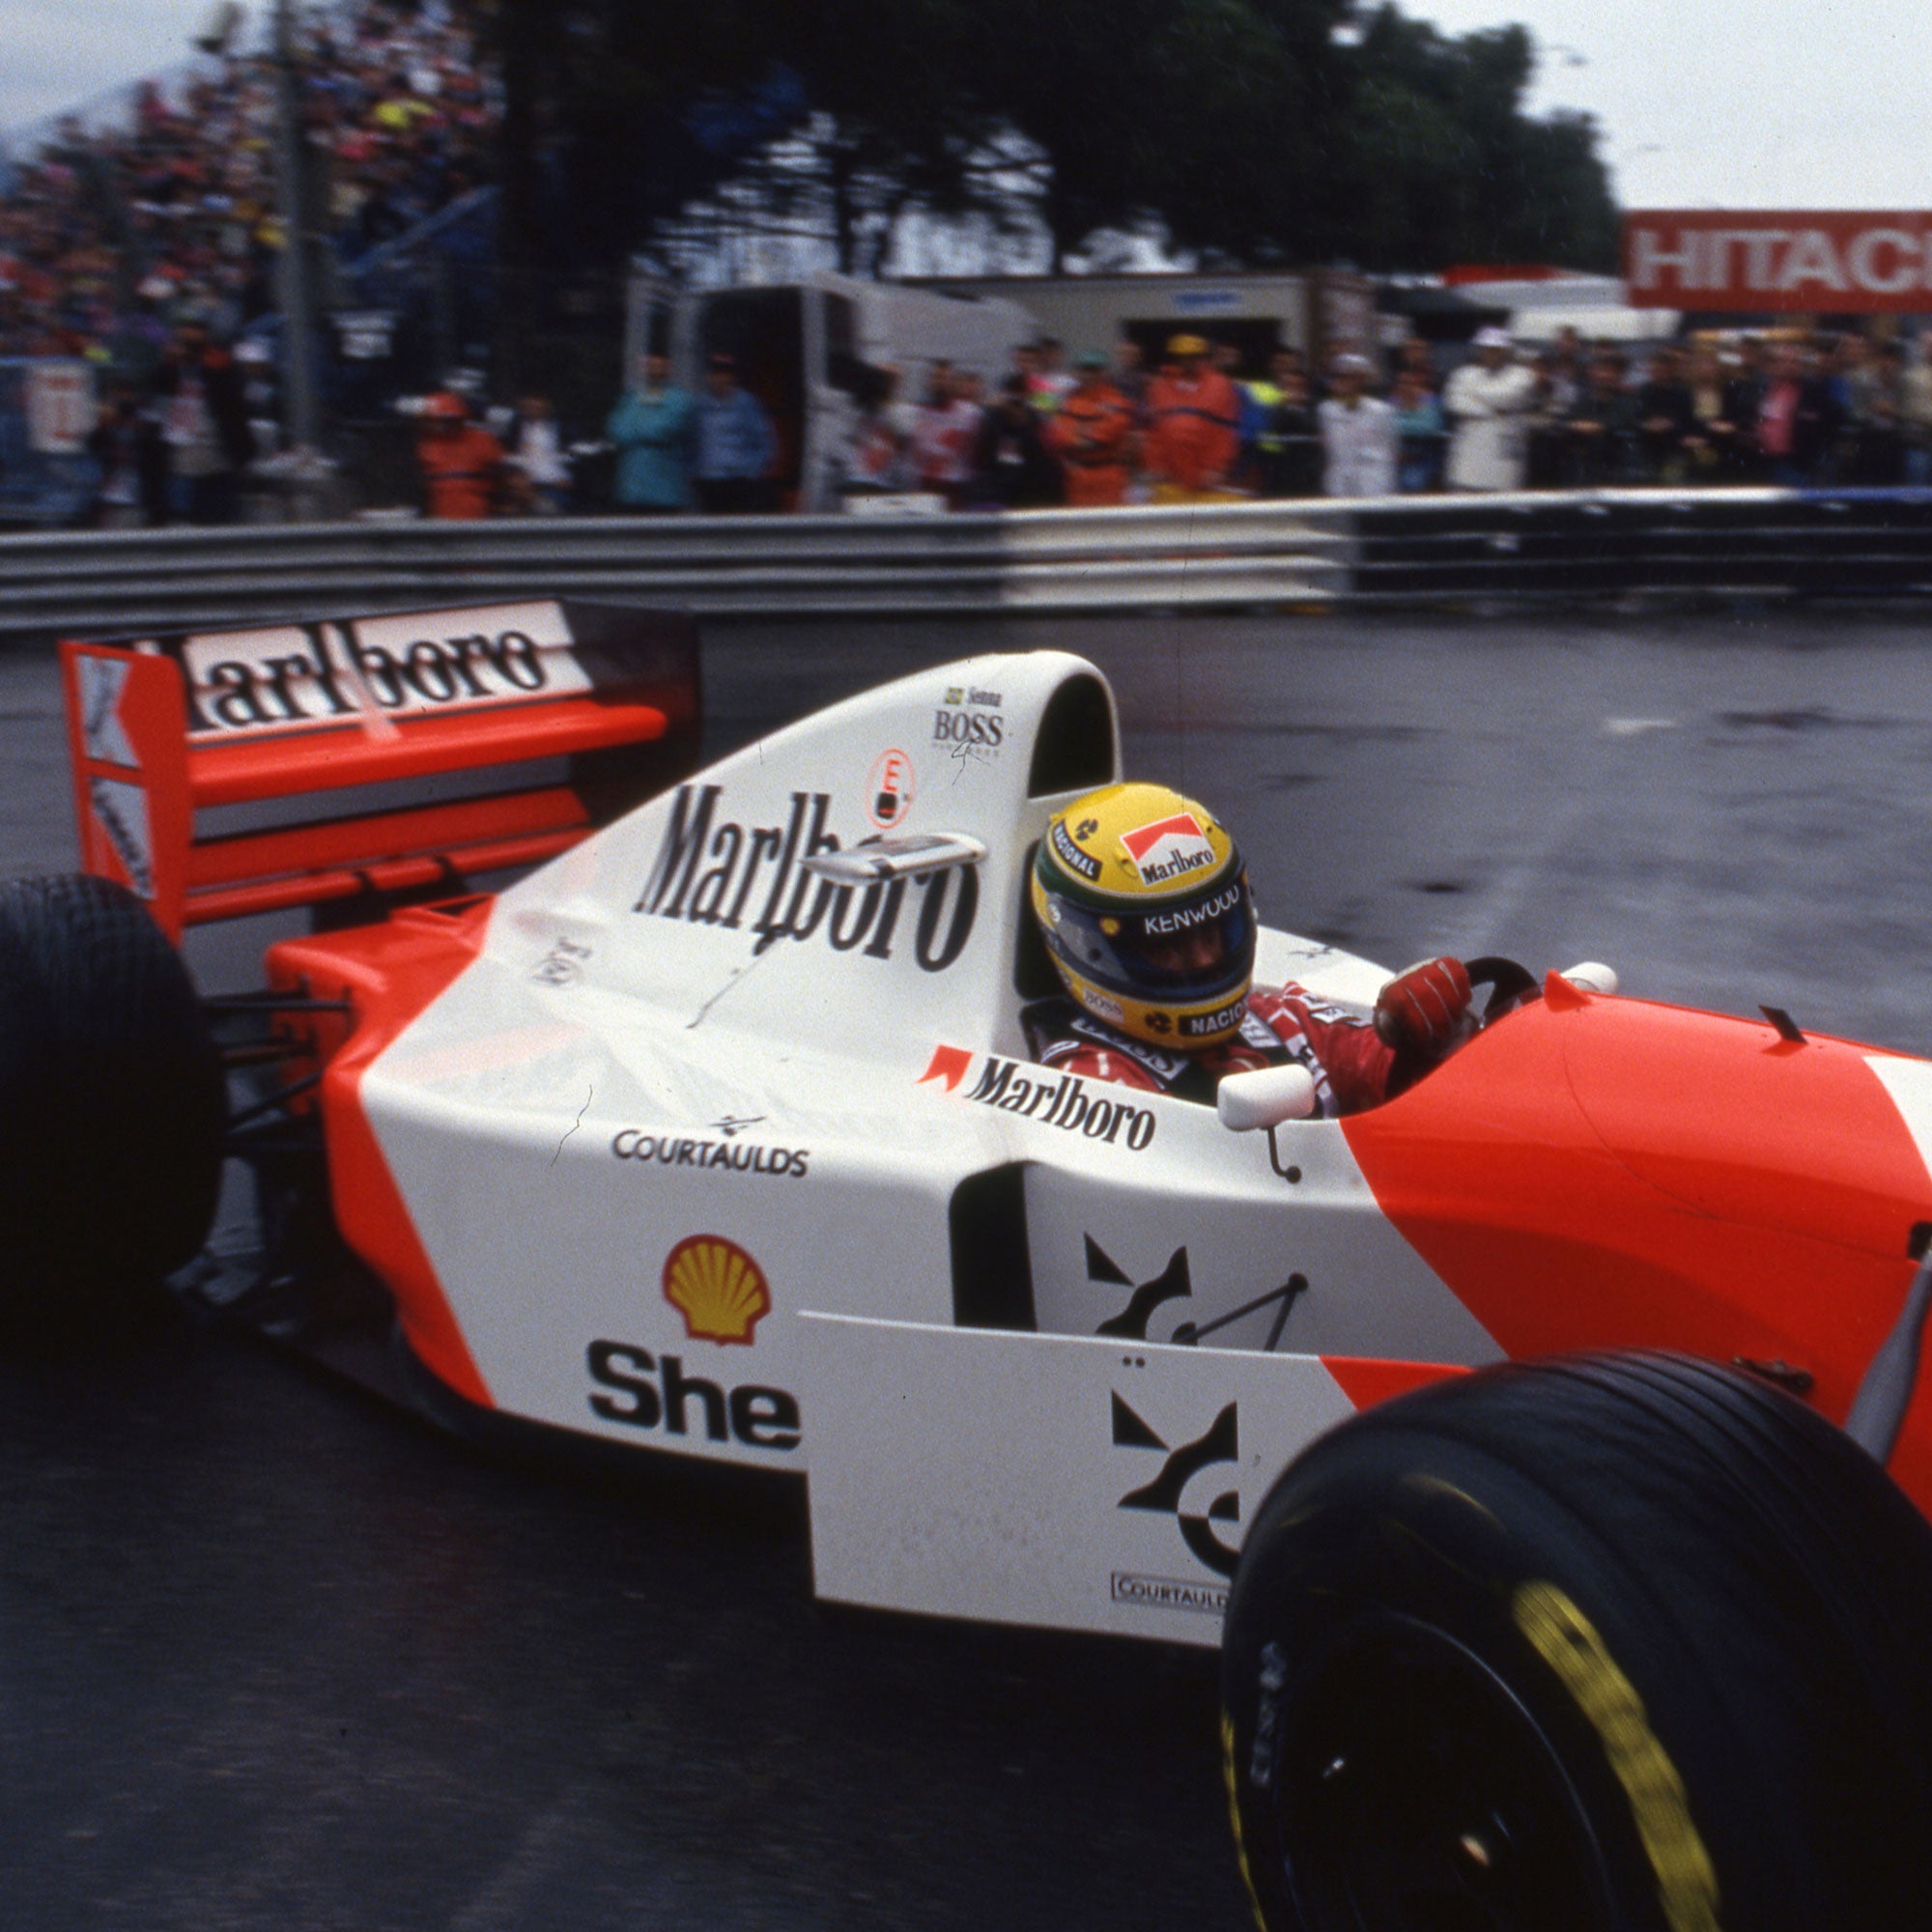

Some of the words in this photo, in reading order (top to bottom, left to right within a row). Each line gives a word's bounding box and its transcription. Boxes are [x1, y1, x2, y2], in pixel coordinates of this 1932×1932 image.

[1633, 228, 1932, 292] HITAC
[184, 619, 546, 728] arlboro
[934, 710, 1004, 747] BOSS
[1141, 848, 1214, 885] Marlboro
[1144, 885, 1239, 935] KENWOOD
[963, 1057, 1155, 1151] Marlboro
[611, 1129, 810, 1178] COURTAULDS
[586, 1339, 802, 1451] She
[1118, 1575, 1229, 1607] COURTAULD
